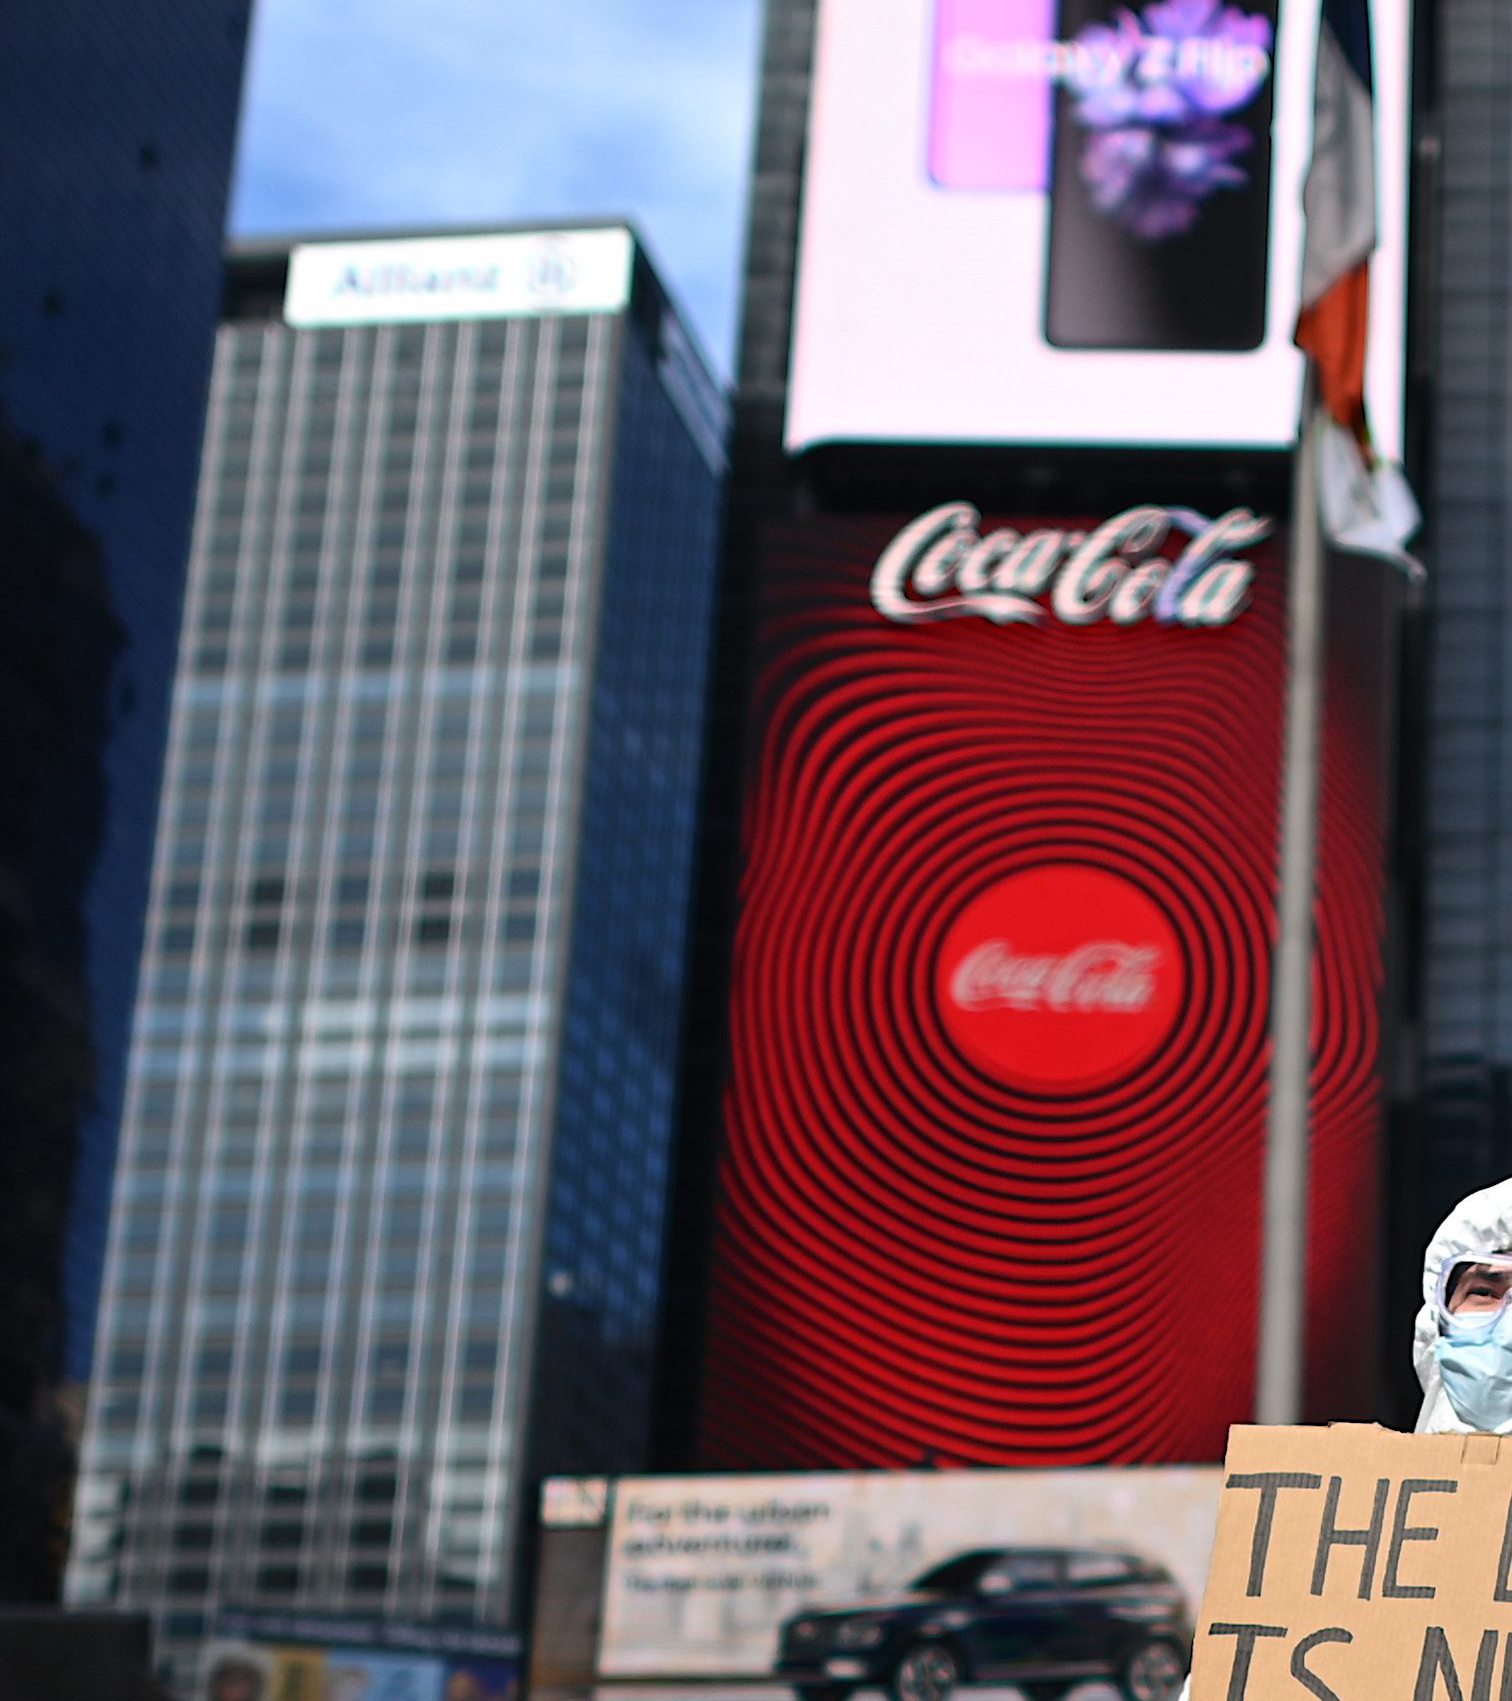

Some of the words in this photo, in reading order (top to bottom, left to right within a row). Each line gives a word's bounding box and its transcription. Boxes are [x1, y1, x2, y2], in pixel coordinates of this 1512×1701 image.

[335, 261, 498, 297] Allianz
[869, 500, 1272, 625] Coca-Cola
[949, 938, 1164, 1014] Coca-Cola
[626, 1499, 672, 1524] For
[680, 1499, 730, 1523] the
[1225, 1472, 1458, 1600] THE
